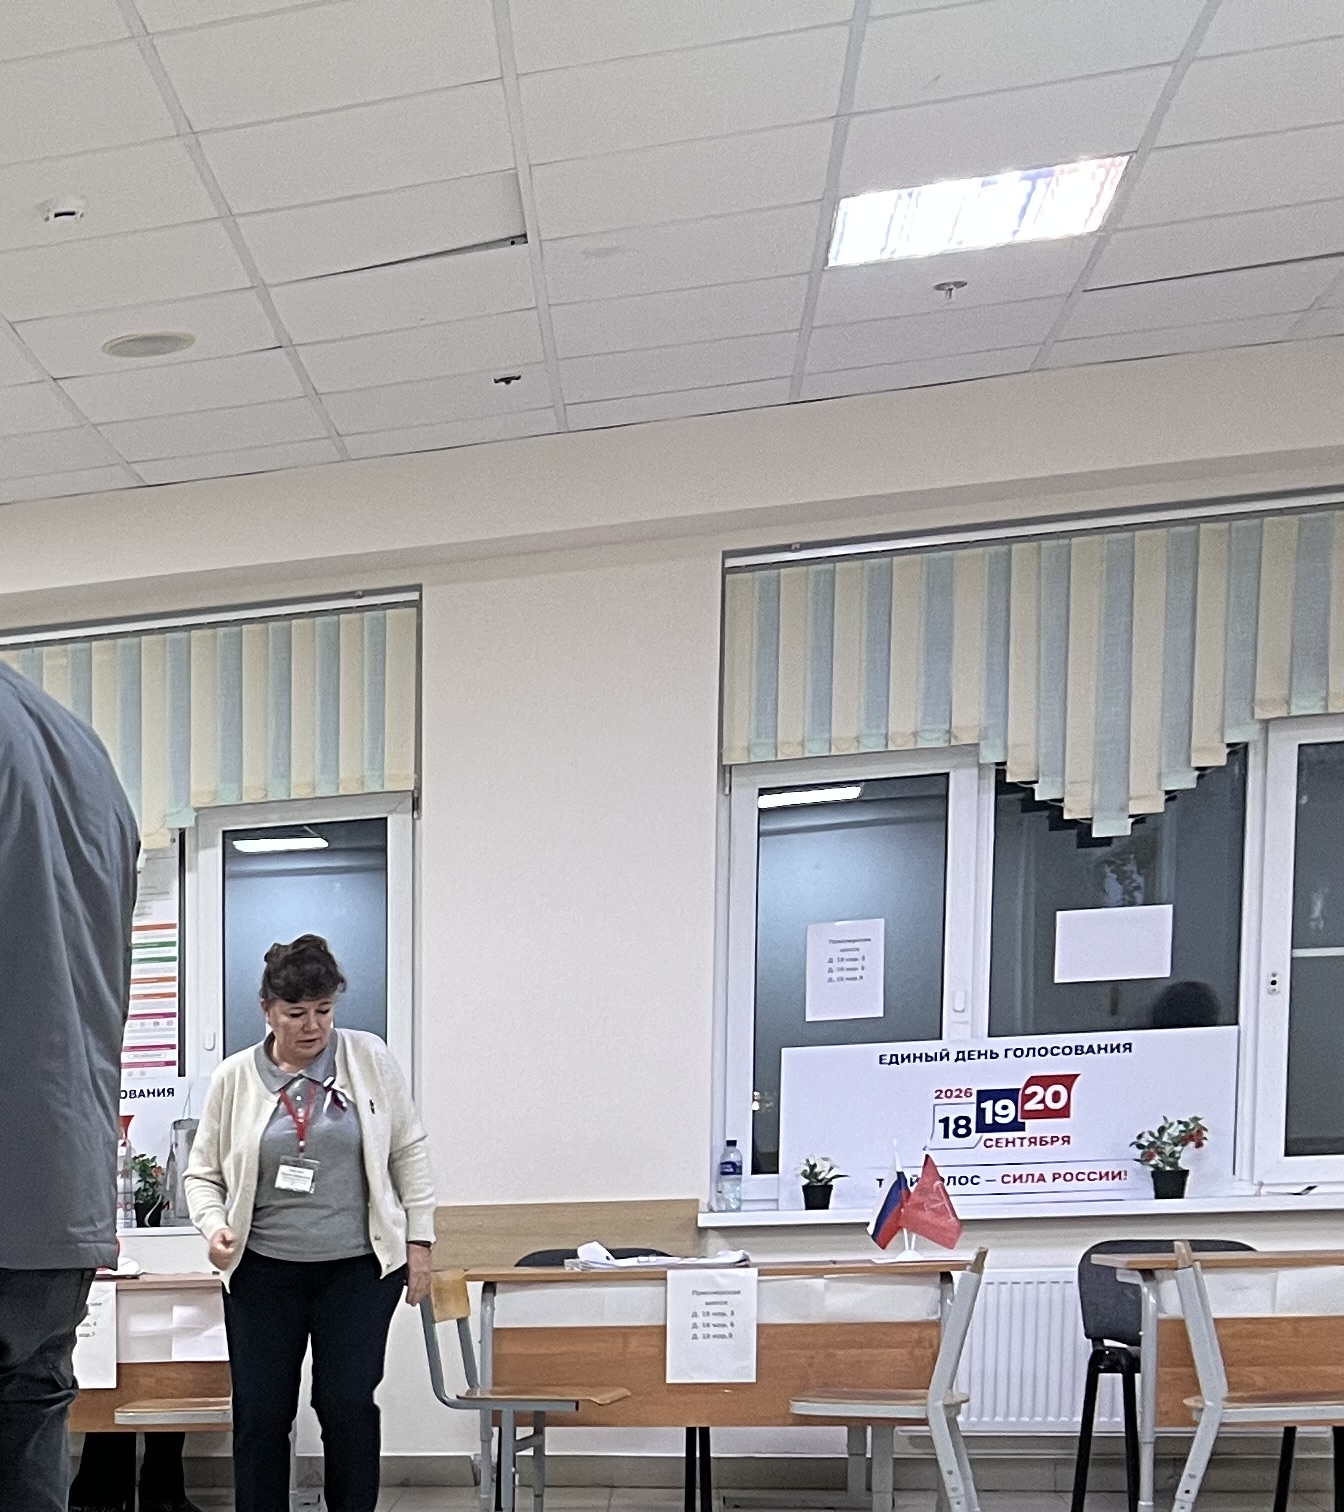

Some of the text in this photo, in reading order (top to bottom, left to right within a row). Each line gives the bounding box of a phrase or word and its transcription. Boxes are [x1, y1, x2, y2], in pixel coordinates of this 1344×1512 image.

[879, 1042, 1133, 1066] ЕДИНЫЙ ДЕНЬ ГОЛОСОВАНИЯ
[120, 1087, 175, 1100] ОВАНИЯ
[934, 1088, 973, 1100] 2026
[938, 1084, 1068, 1139] 18 19 20
[983, 1135, 1071, 1148] СЕНТЯБРЯ
[1001, 1172, 1047, 1184] СИЛА
[1052, 1170, 1128, 1183] РОССИИ!
